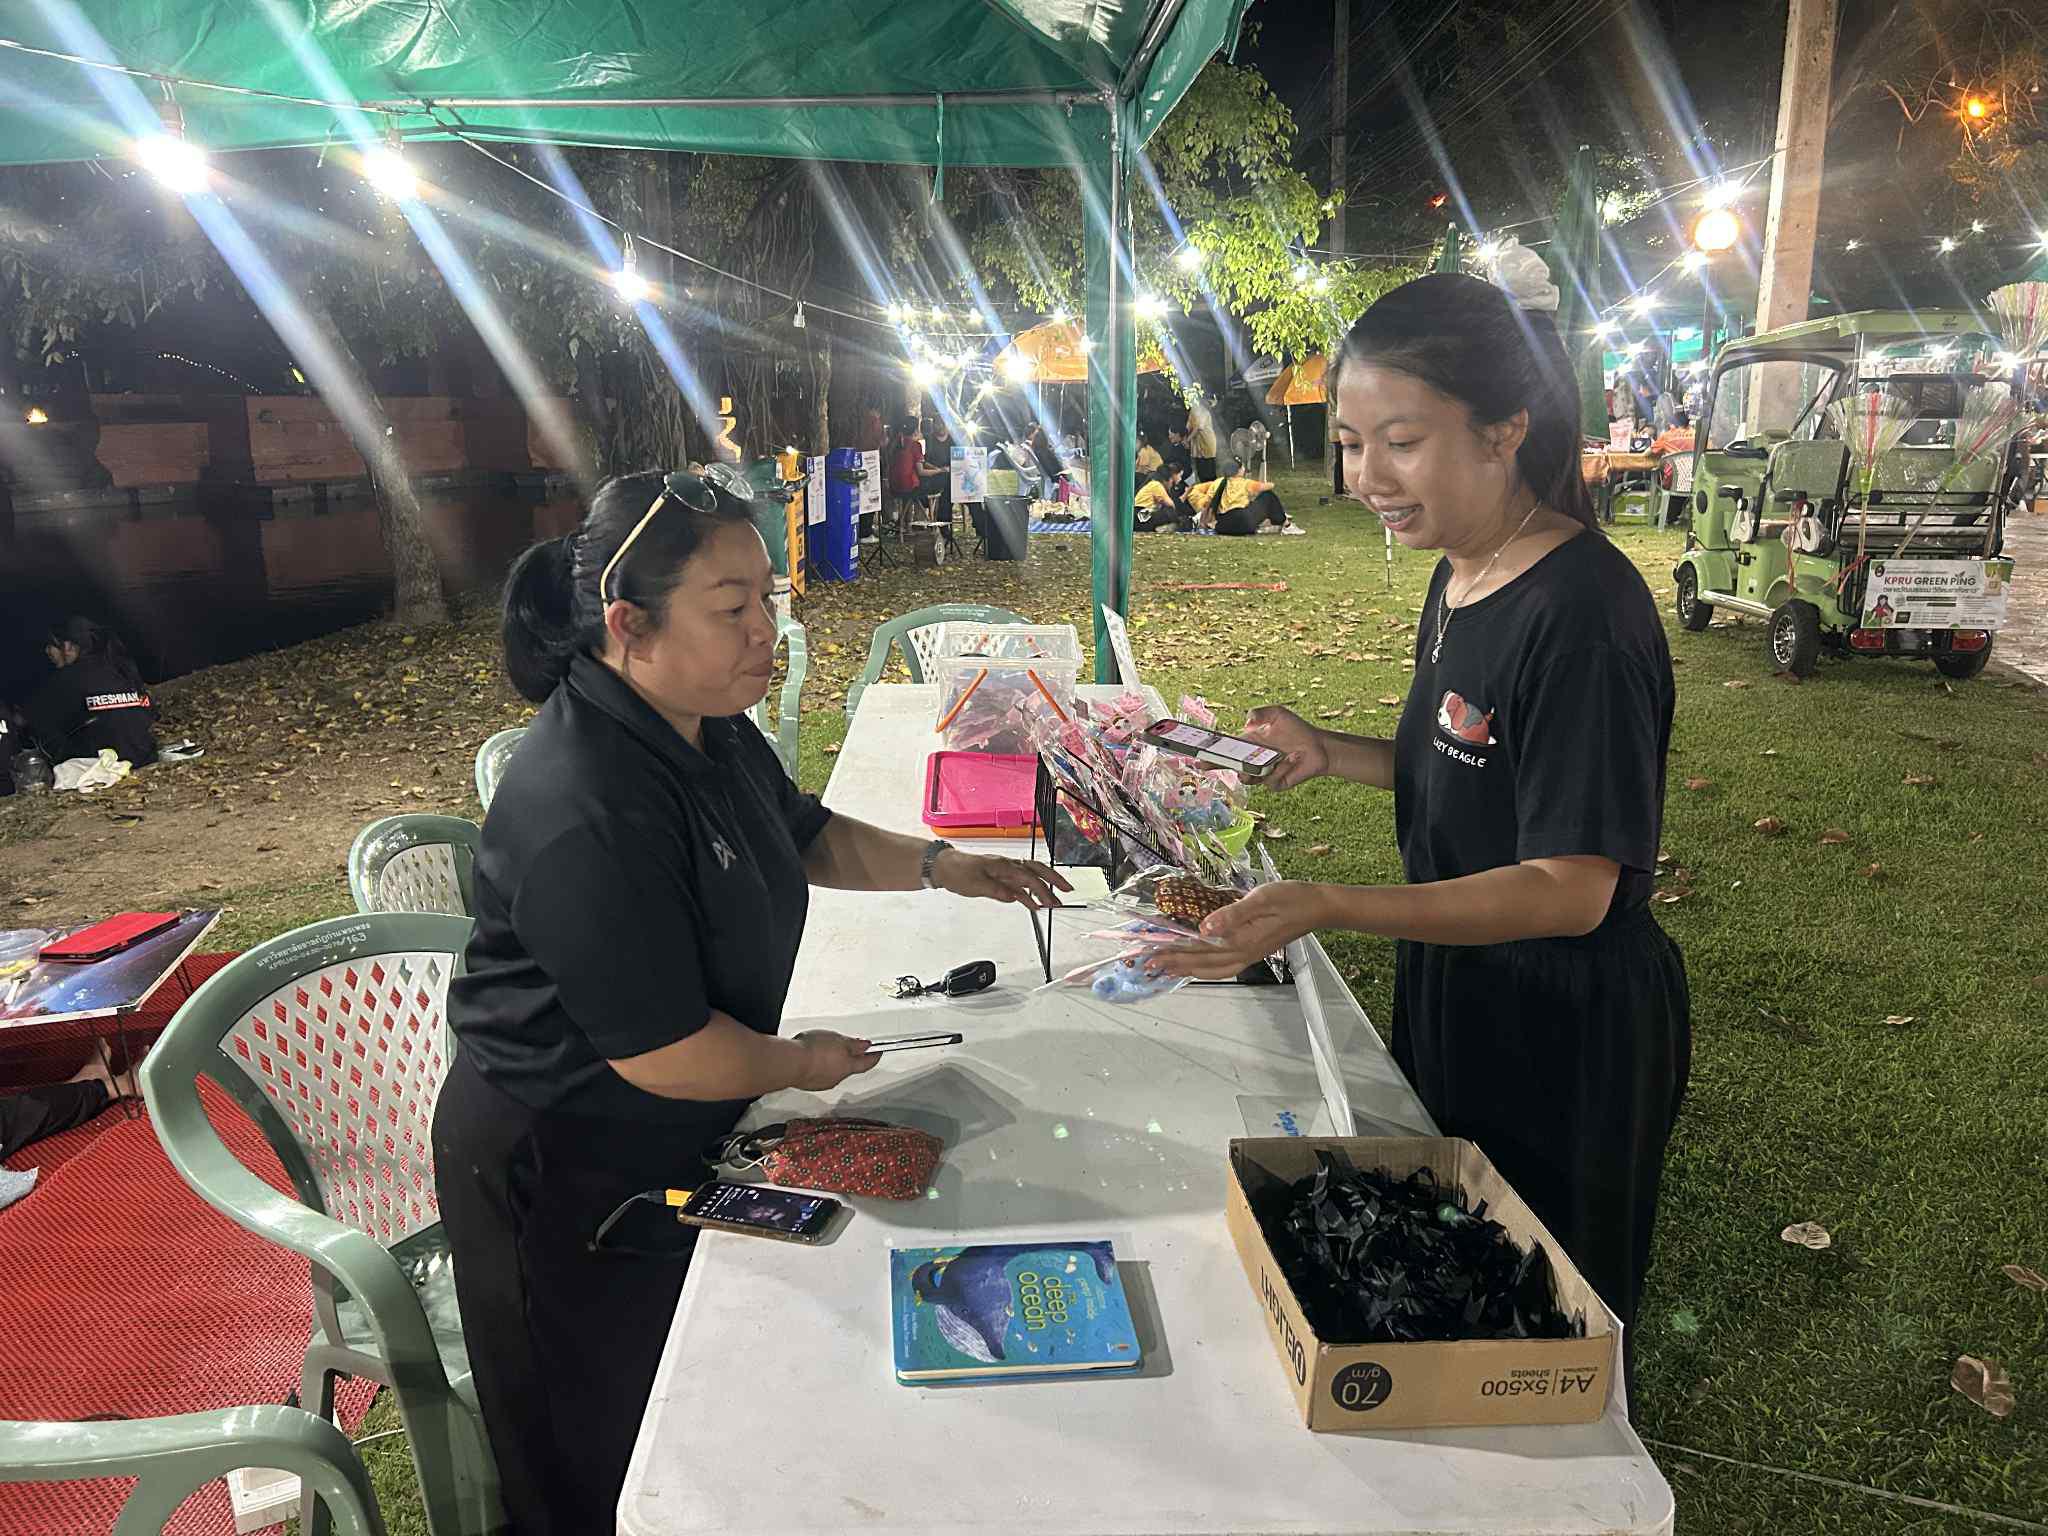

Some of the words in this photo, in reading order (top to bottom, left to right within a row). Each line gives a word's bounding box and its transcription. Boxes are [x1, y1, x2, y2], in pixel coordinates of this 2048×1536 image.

[1884, 576, 1912, 585] KPRU
[1914, 576, 1947, 586] GREEN
[86, 691, 139, 707] FRESHMAN
[1447, 746, 1487, 767] BEAGLE
[1019, 1271, 1046, 1331] ocean
[1043, 1276, 1072, 1323] deep
[1510, 1368, 1551, 1378] sheets
[1560, 1373, 1596, 1394] A4
[1342, 1382, 1379, 1405] 70
[1481, 1379, 1549, 1396] 5x500
